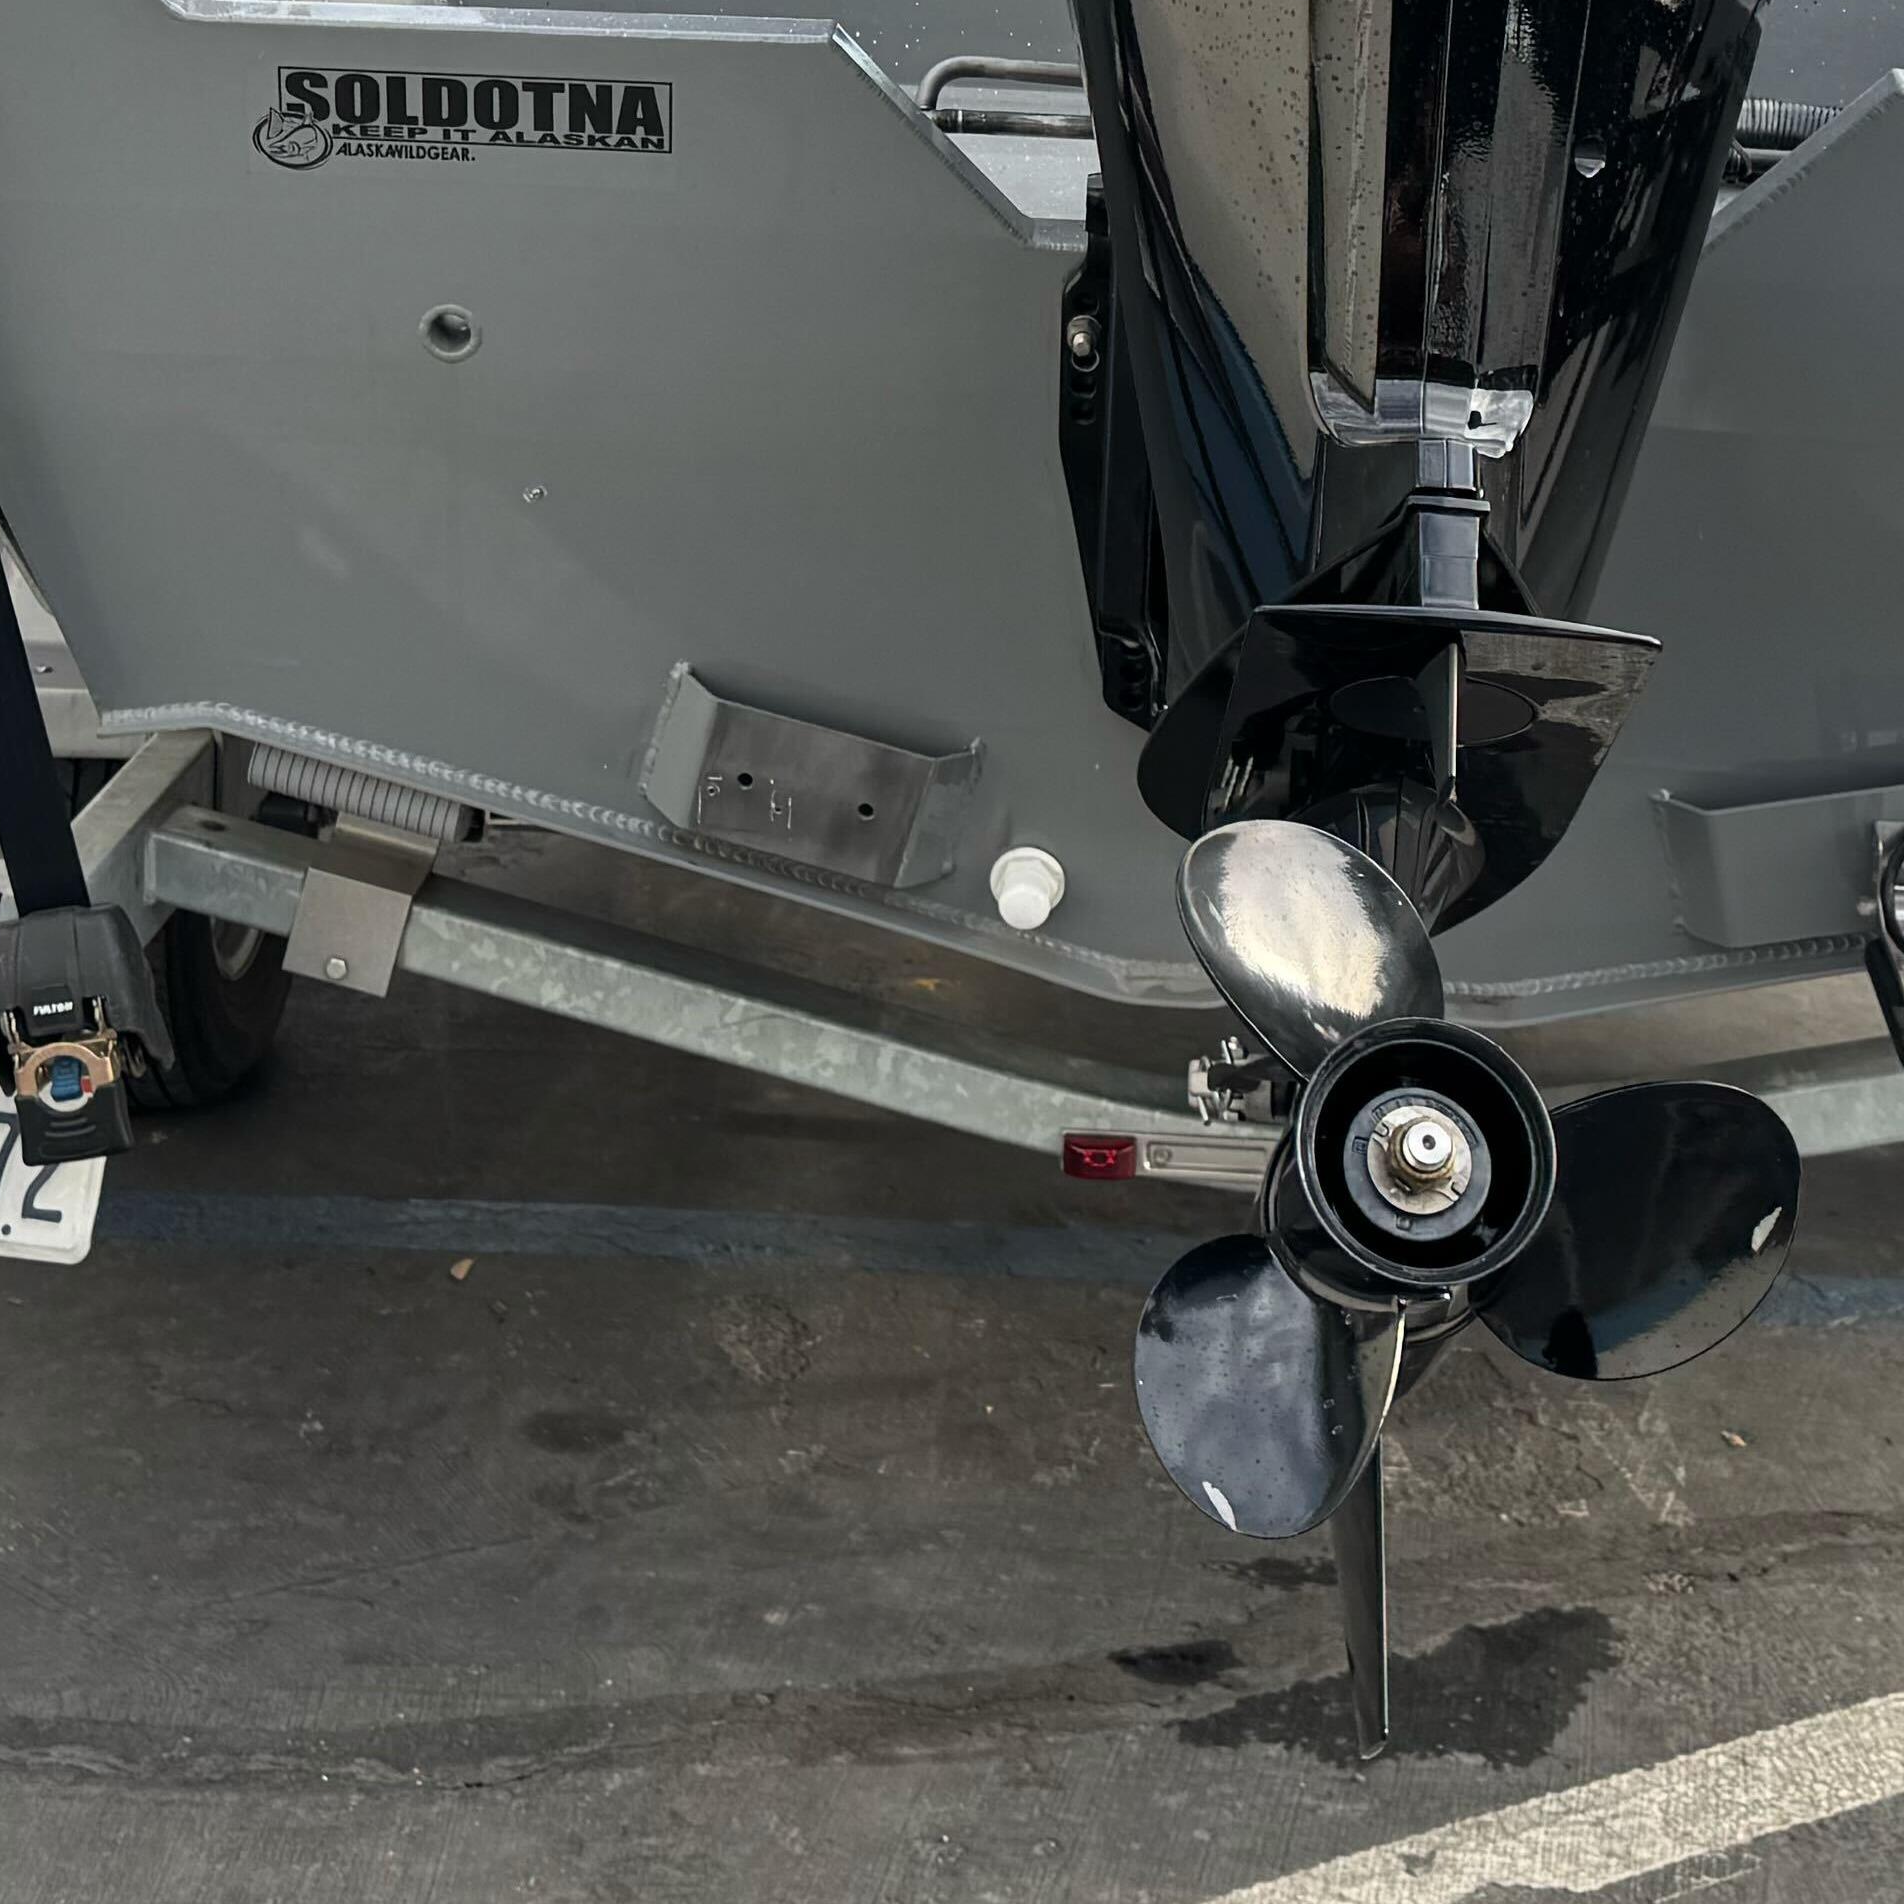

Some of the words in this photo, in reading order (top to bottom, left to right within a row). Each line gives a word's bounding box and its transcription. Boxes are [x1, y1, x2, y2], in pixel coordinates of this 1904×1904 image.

[284, 71, 665, 138] SOLDOTNA
[331, 123, 427, 138] KEEP
[443, 129, 476, 142] IT
[488, 130, 665, 150] ALASKAN
